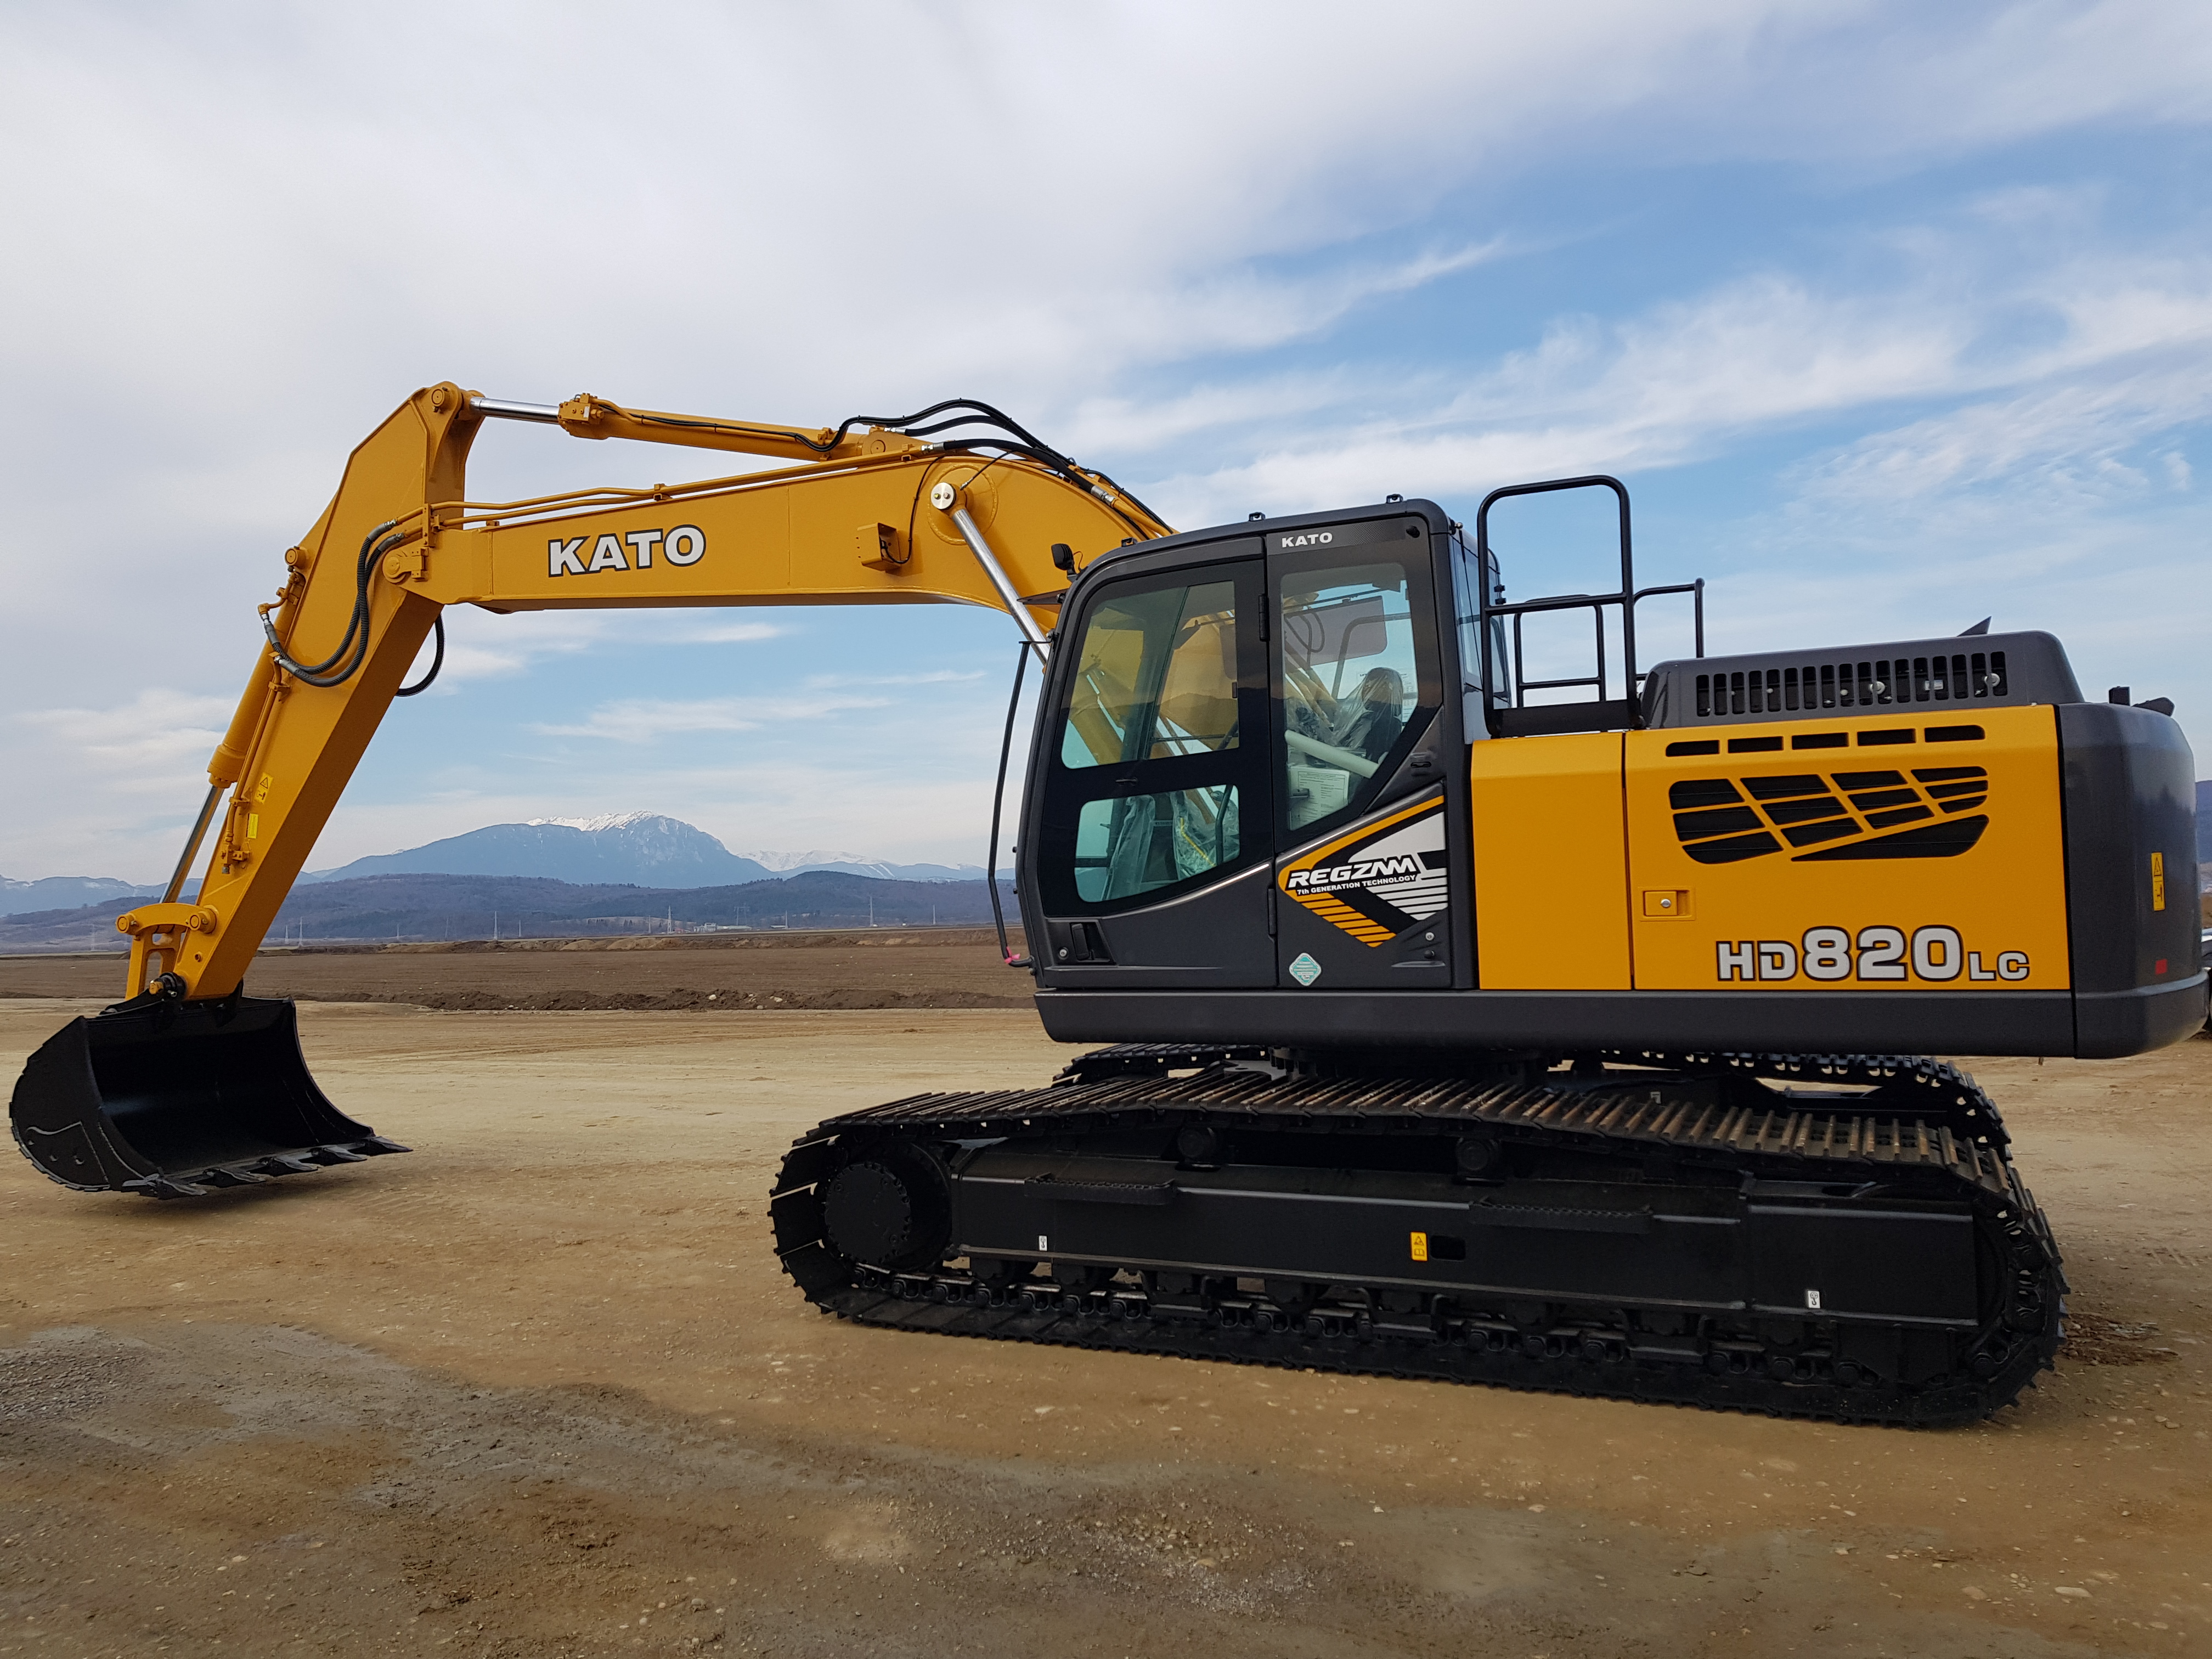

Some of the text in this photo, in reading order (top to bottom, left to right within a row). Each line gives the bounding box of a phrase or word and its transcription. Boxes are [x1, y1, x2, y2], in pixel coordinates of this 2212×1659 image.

[1282, 532, 1333, 548] KATO
[549, 524, 706, 577] KATO
[1311, 881, 1361, 893] GENERATION
[1362, 874, 1416, 886] TECHNOLOGY
